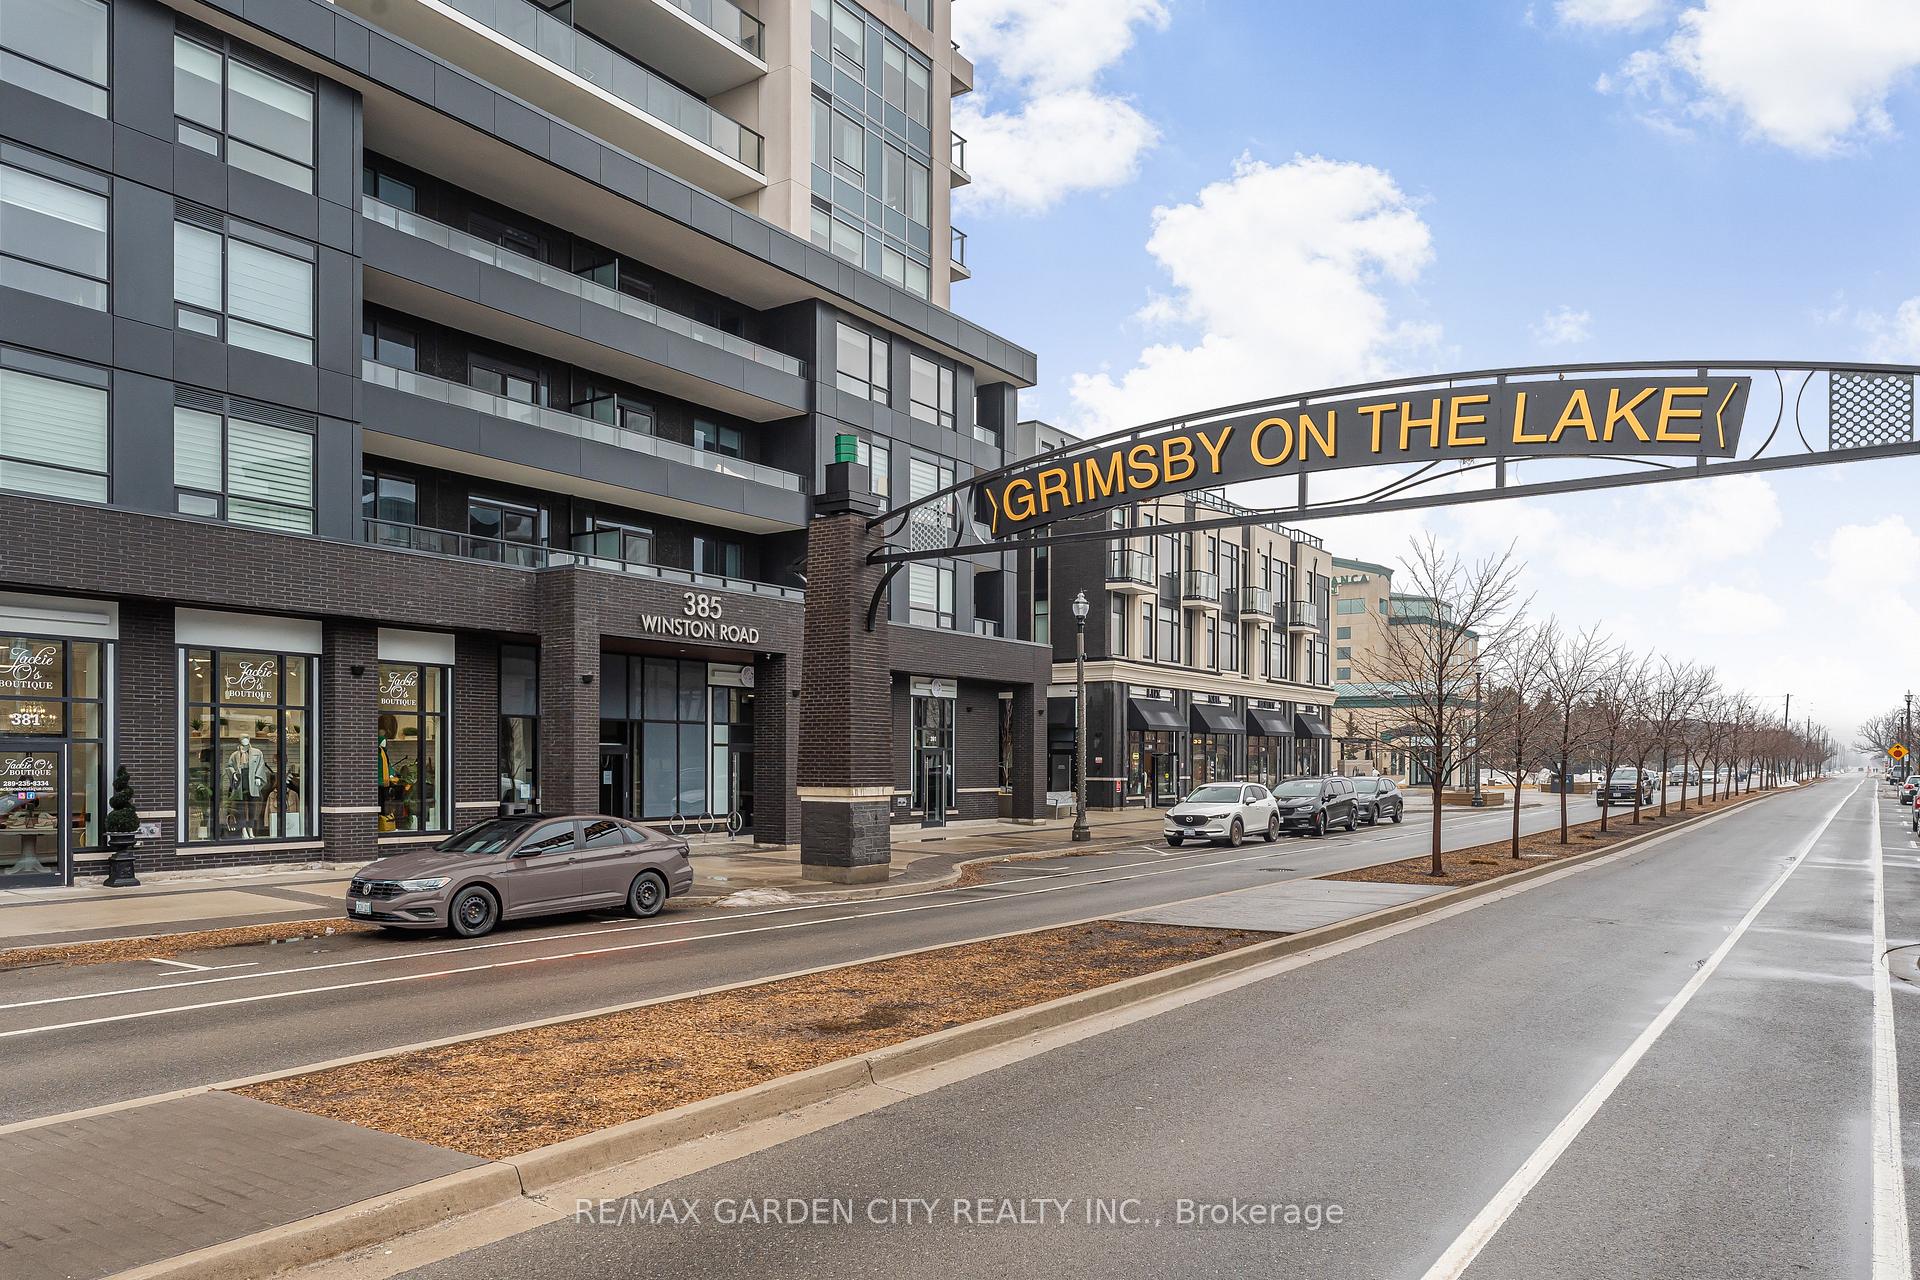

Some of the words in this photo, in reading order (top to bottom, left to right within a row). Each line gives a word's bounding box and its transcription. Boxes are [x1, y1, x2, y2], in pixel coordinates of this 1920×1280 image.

[1003, 426, 1233, 522] GRIMSBY
[1250, 410, 1337, 467] ON
[1357, 394, 1489, 454] THE
[1512, 386, 1708, 443] LAKE
[1331, 574, 1369, 585] ANCA
[683, 592, 722, 619] 385
[641, 614, 716, 639] WINSTON
[720, 624, 759, 643] ROAD
[0, 646, 56, 673] Jackie
[13, 664, 42, 680] O's
[229, 661, 275, 685] Jackie
[0, 680, 53, 691] BOUTIQUE
[241, 676, 263, 690] O's
[380, 671, 418, 693] Jackie
[229, 690, 272, 699] BOUTIQUE
[390, 686, 409, 698] O's
[381, 698, 417, 706] BOUTIQUE
[11, 713, 40, 725] 381
[0, 757, 34, 775] Jackie
[34, 759, 53, 770] O's
